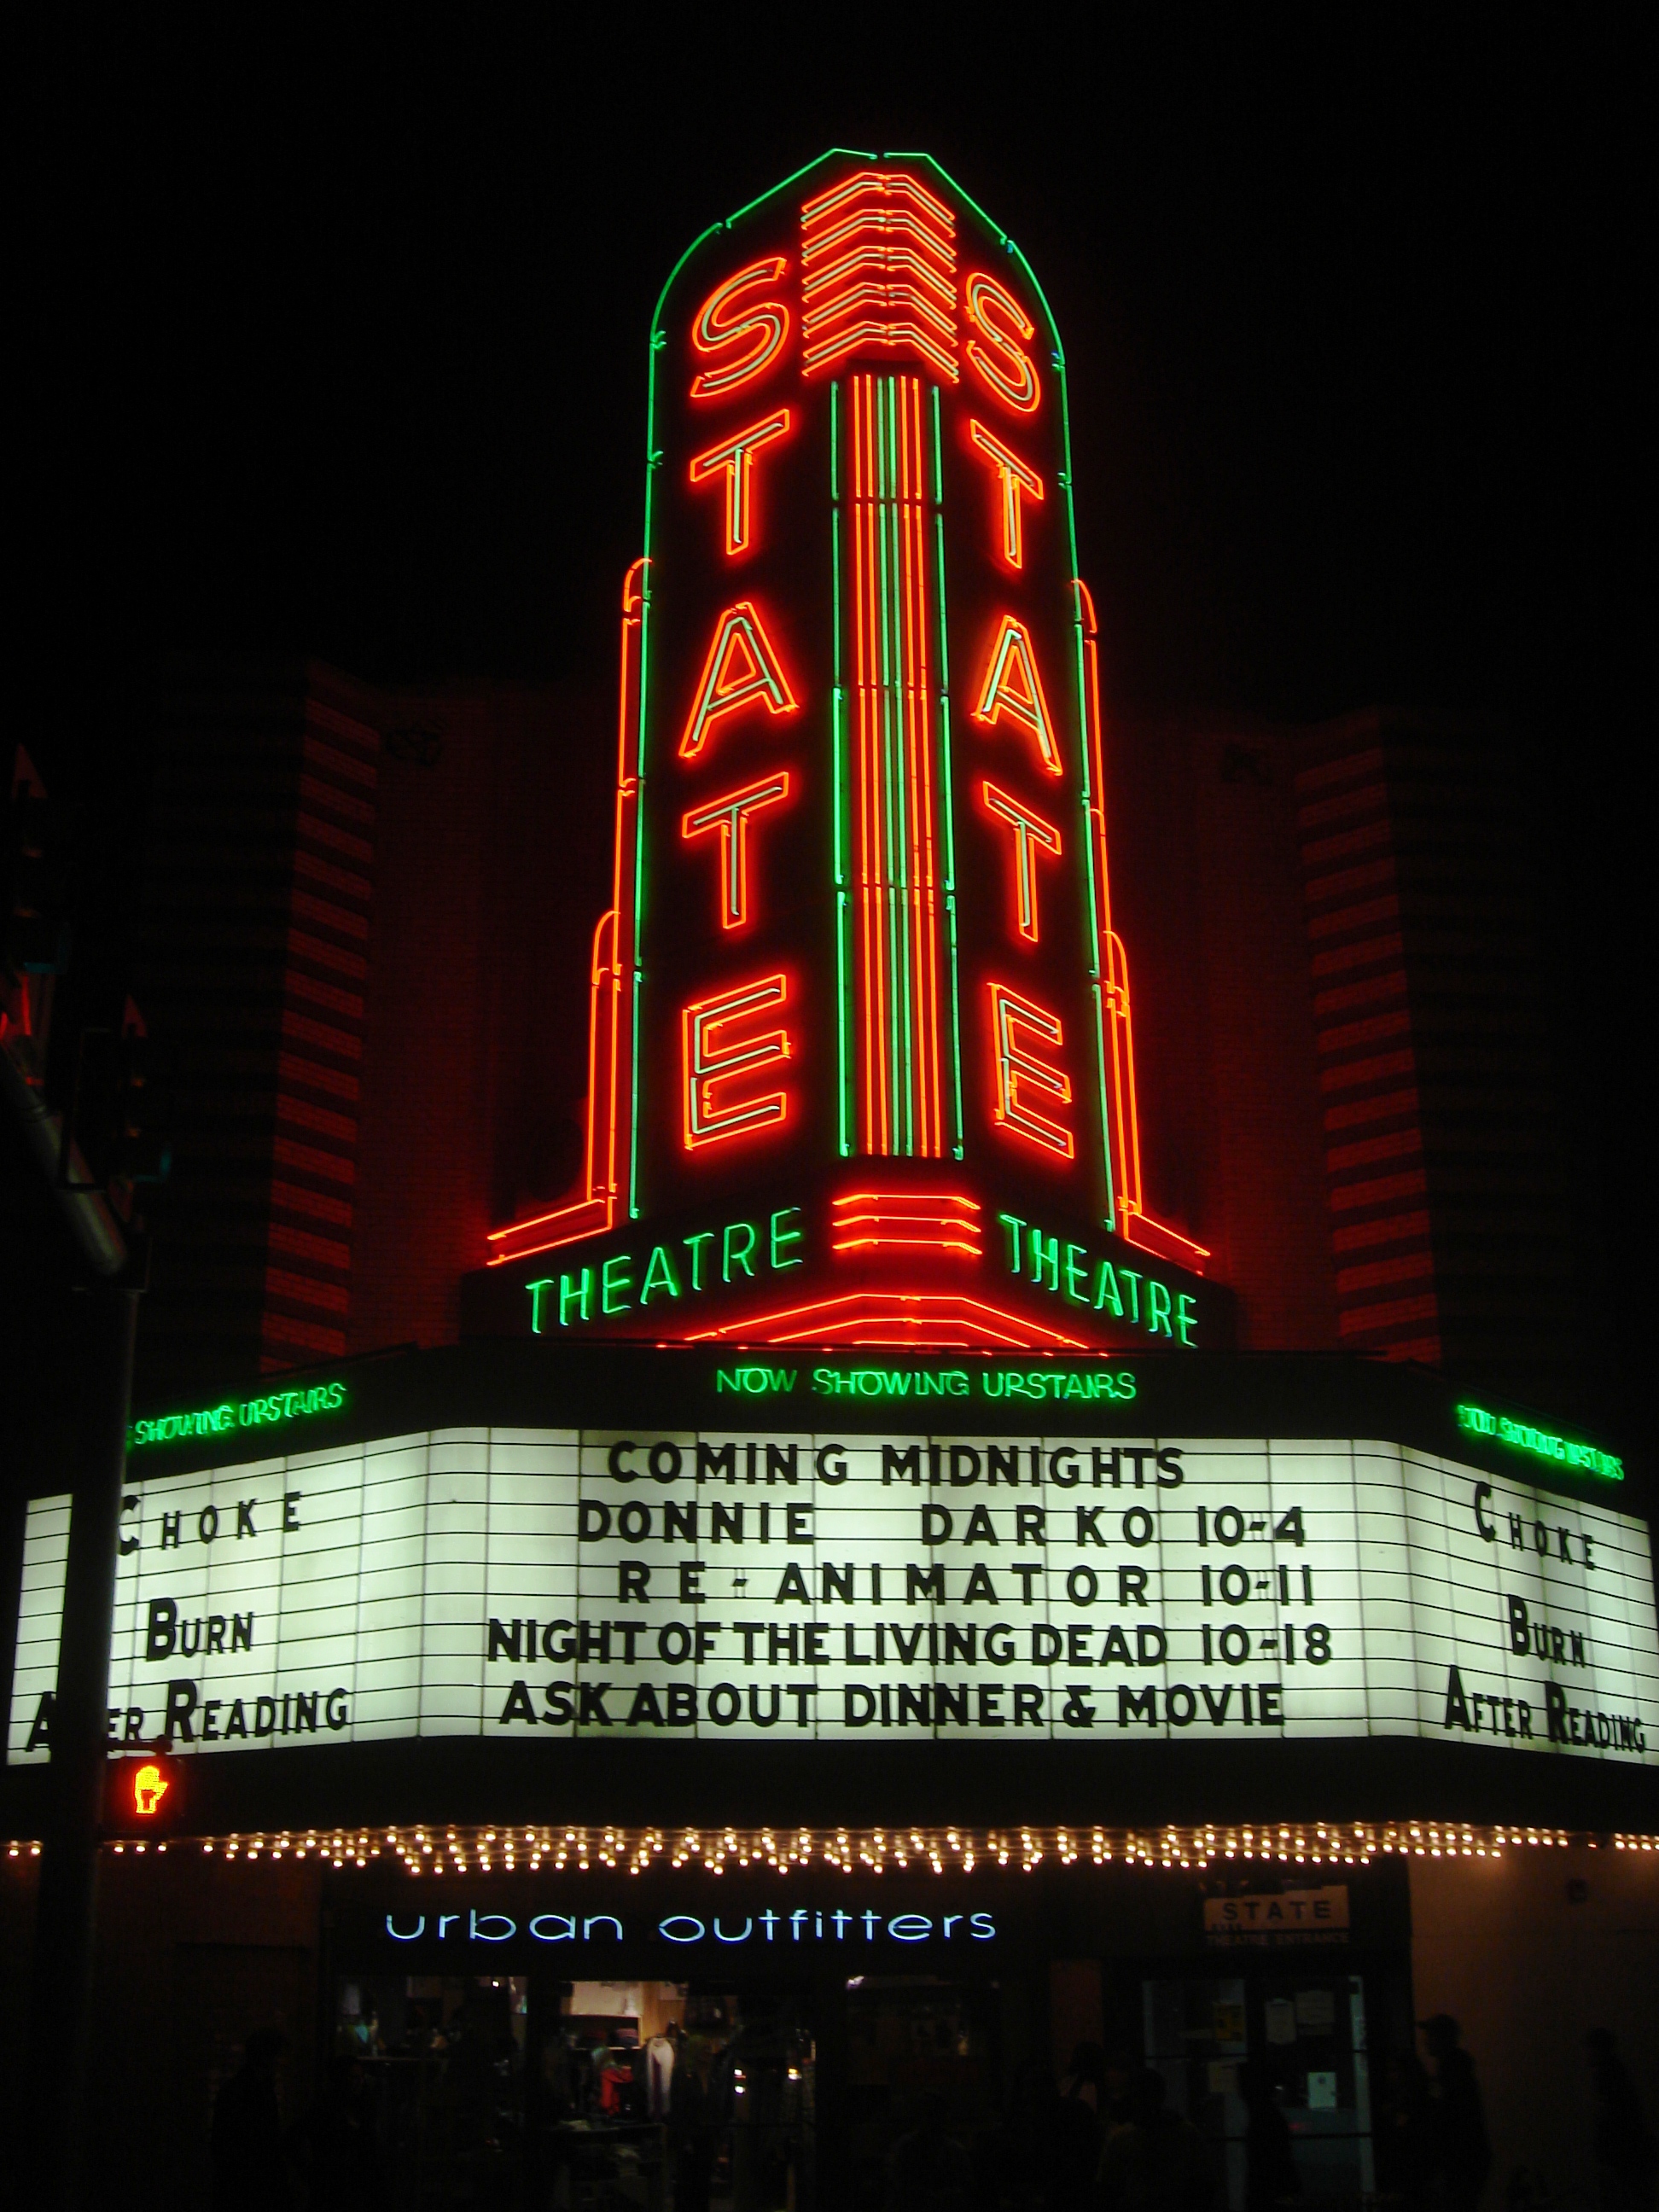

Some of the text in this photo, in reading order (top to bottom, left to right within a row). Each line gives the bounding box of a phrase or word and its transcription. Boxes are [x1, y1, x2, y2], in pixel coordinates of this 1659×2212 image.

[679, 257, 800, 1150] STATE
[965, 272, 1074, 1159] STATE
[525, 1207, 804, 1334] THEATRE
[999, 1214, 1199, 1348] THEATRE
[134, 1404, 236, 1445] SHOWING
[238, 1382, 348, 1427] UPSTAIRS
[716, 1368, 1137, 1400] NOW SHOWING UPSTAIRS
[608, 1441, 1185, 1490] COMING MIDNIGHTS
[579, 1499, 1306, 1547] DONNIE DARKO 10-4
[1475, 1481, 1595, 1570] CHOKE
[1202, 1564, 1313, 1607] 10-11
[146, 1597, 253, 1662] BURN
[488, 1619, 1332, 1667] NIGHT OF THE LIVING DEAD 10-18
[1508, 1594, 1586, 1668] BURN
[26, 1679, 349, 1752] AER READING
[500, 1680, 1284, 1728] ASK ABOUT DINNER & MOVIE
[1444, 1664, 1646, 1753] AFTER READING
[386, 1909, 997, 1942] urban outfitters
[1222, 1900, 1332, 1920] STATE
